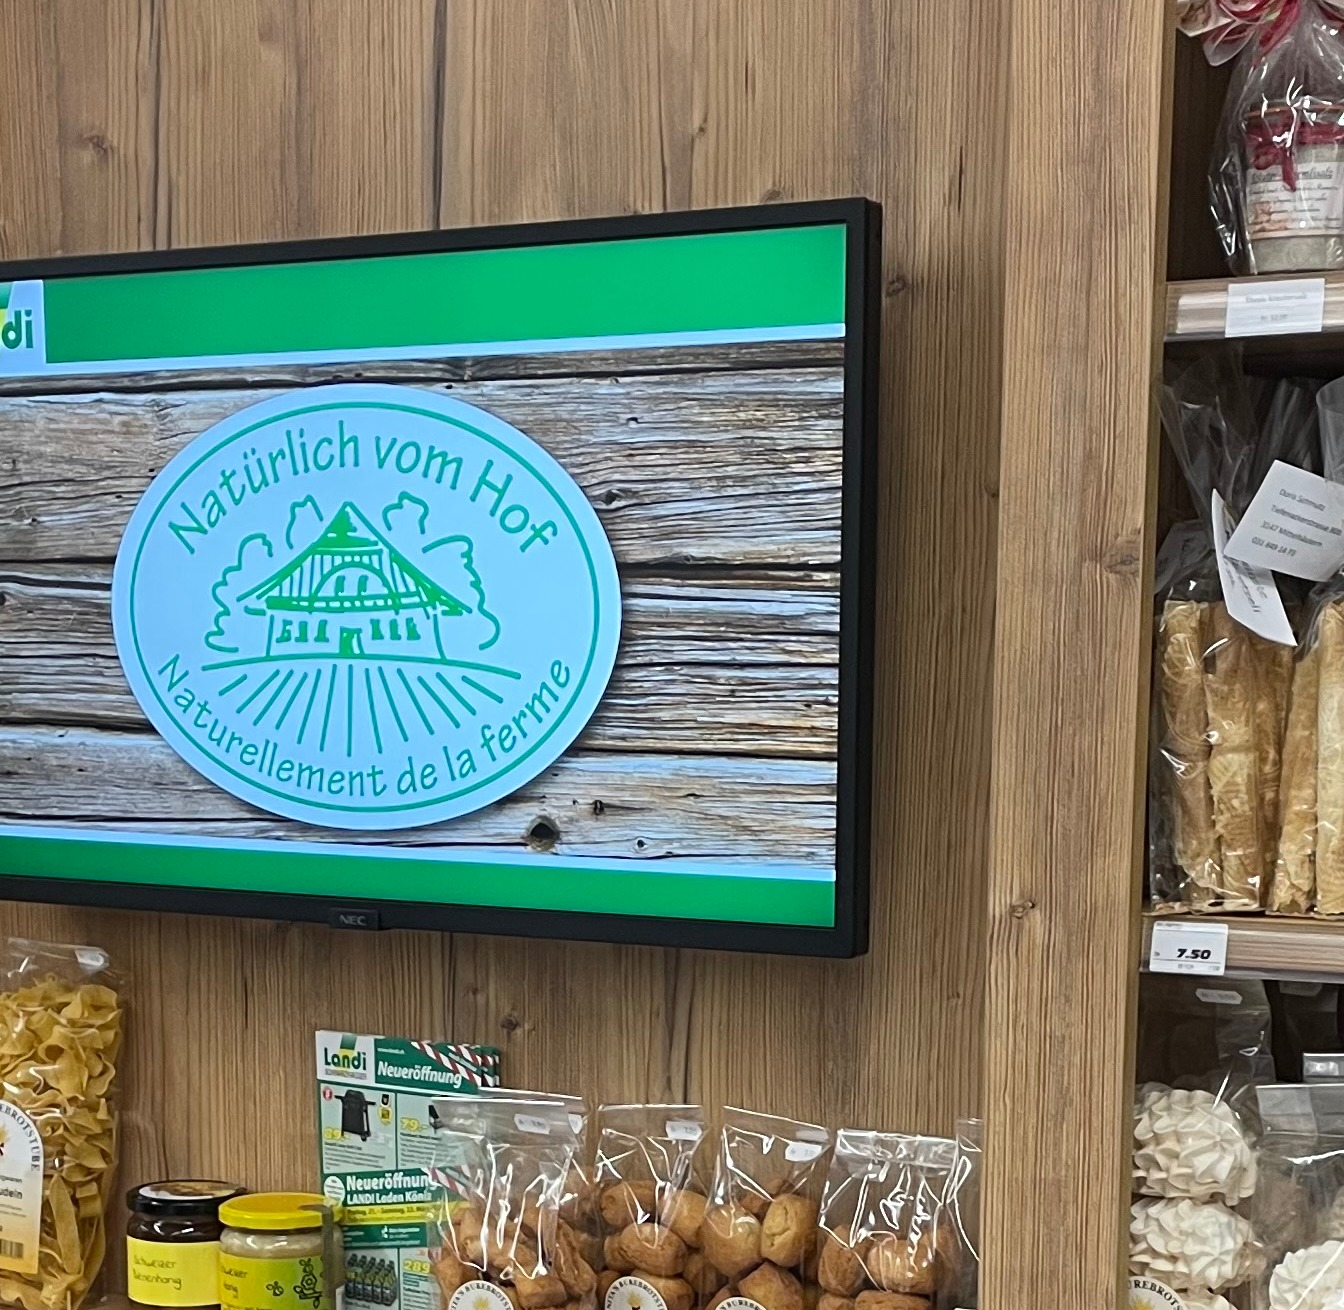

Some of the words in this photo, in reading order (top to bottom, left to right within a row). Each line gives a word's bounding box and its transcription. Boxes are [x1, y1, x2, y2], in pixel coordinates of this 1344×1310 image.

[167, 420, 360, 554] Natürlich
[374, 434, 463, 490] vom
[471, 458, 560, 554] Hof
[156, 652, 385, 799] Naturellement
[395, 761, 439, 796] de
[447, 740, 479, 784] la
[482, 656, 572, 769] ferme
[1176, 948, 1212, 961] 7.50
[323, 1047, 367, 1071] Landi
[377, 1060, 463, 1089] Neueröffnung
[347, 1192, 376, 1205] LANDI
[376, 1191, 405, 1204] Laden
